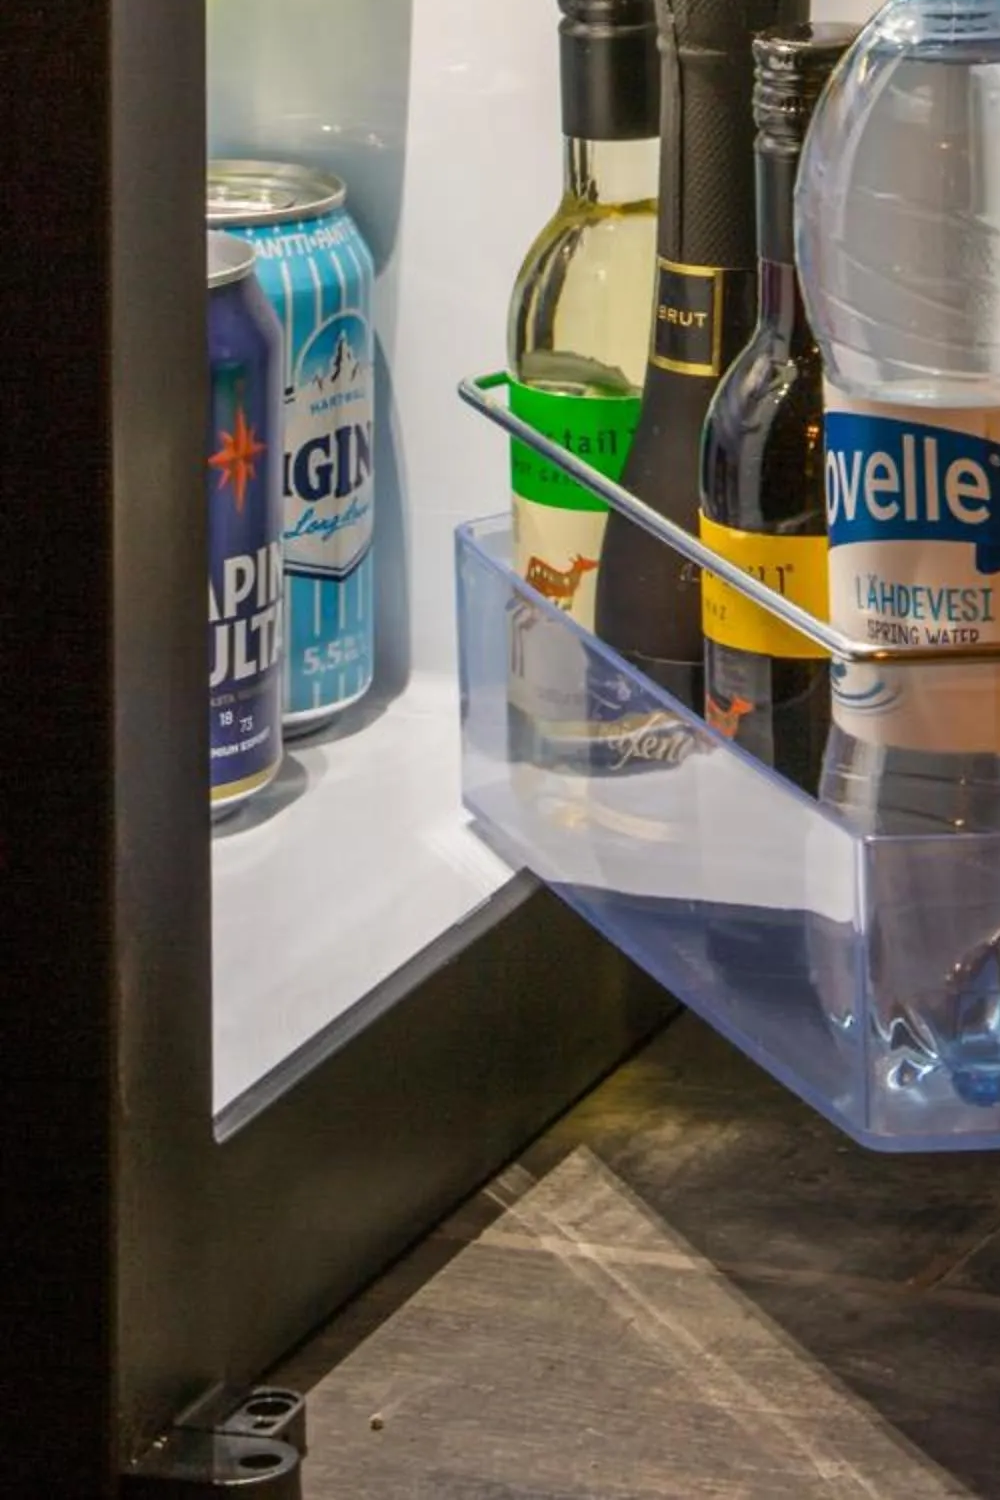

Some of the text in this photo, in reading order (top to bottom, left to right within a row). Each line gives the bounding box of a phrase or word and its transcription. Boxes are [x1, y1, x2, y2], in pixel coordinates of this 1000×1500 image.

[658, 304, 708, 328] BRUT
[855, 575, 996, 622] LÄHDEVESI
[867, 620, 980, 645] SPRING WATER
